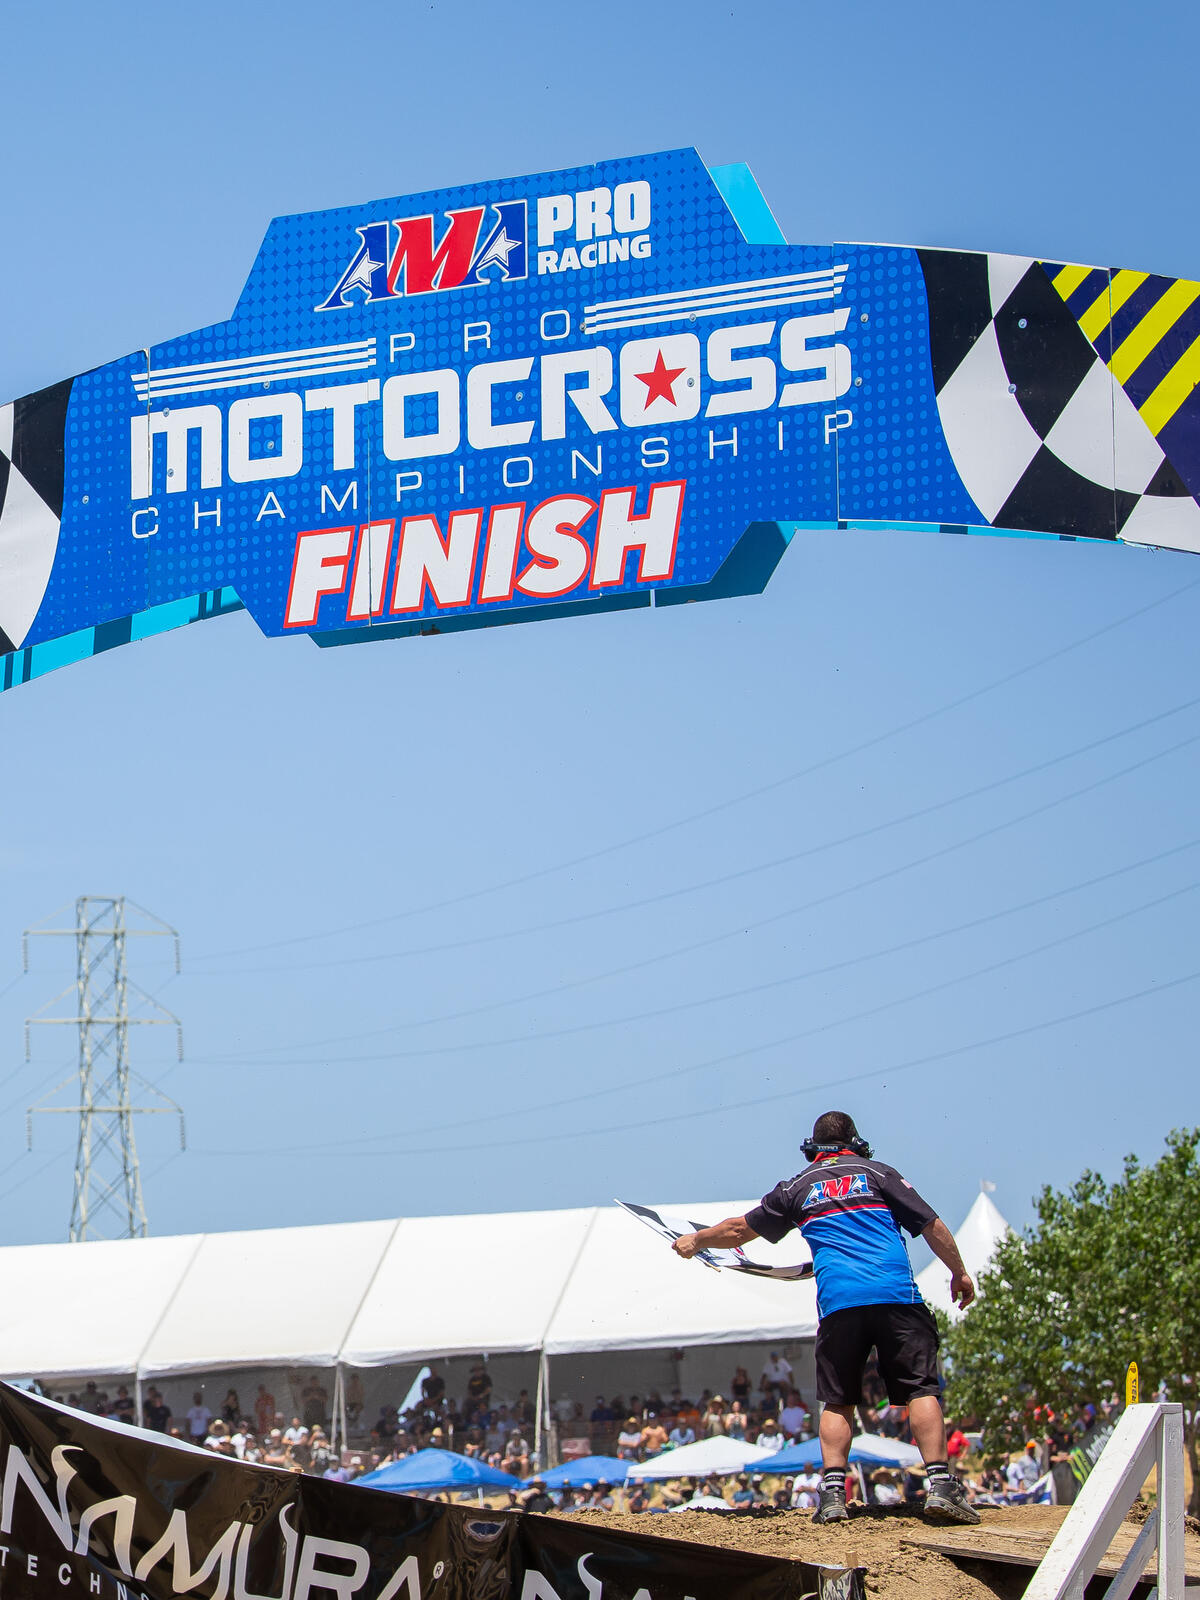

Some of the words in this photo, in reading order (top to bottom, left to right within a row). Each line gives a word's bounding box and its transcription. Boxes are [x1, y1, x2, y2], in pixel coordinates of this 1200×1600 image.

[314, 199, 528, 312] AMA
[536, 180, 651, 247] PRO
[536, 234, 652, 275] RACING
[389, 309, 572, 363] PRO
[131, 307, 852, 499] MOTOCROSS
[131, 409, 854, 540] CHAMPIONSHIP
[284, 479, 688, 629] FINISH
[801, 1174, 874, 1208] AMA
